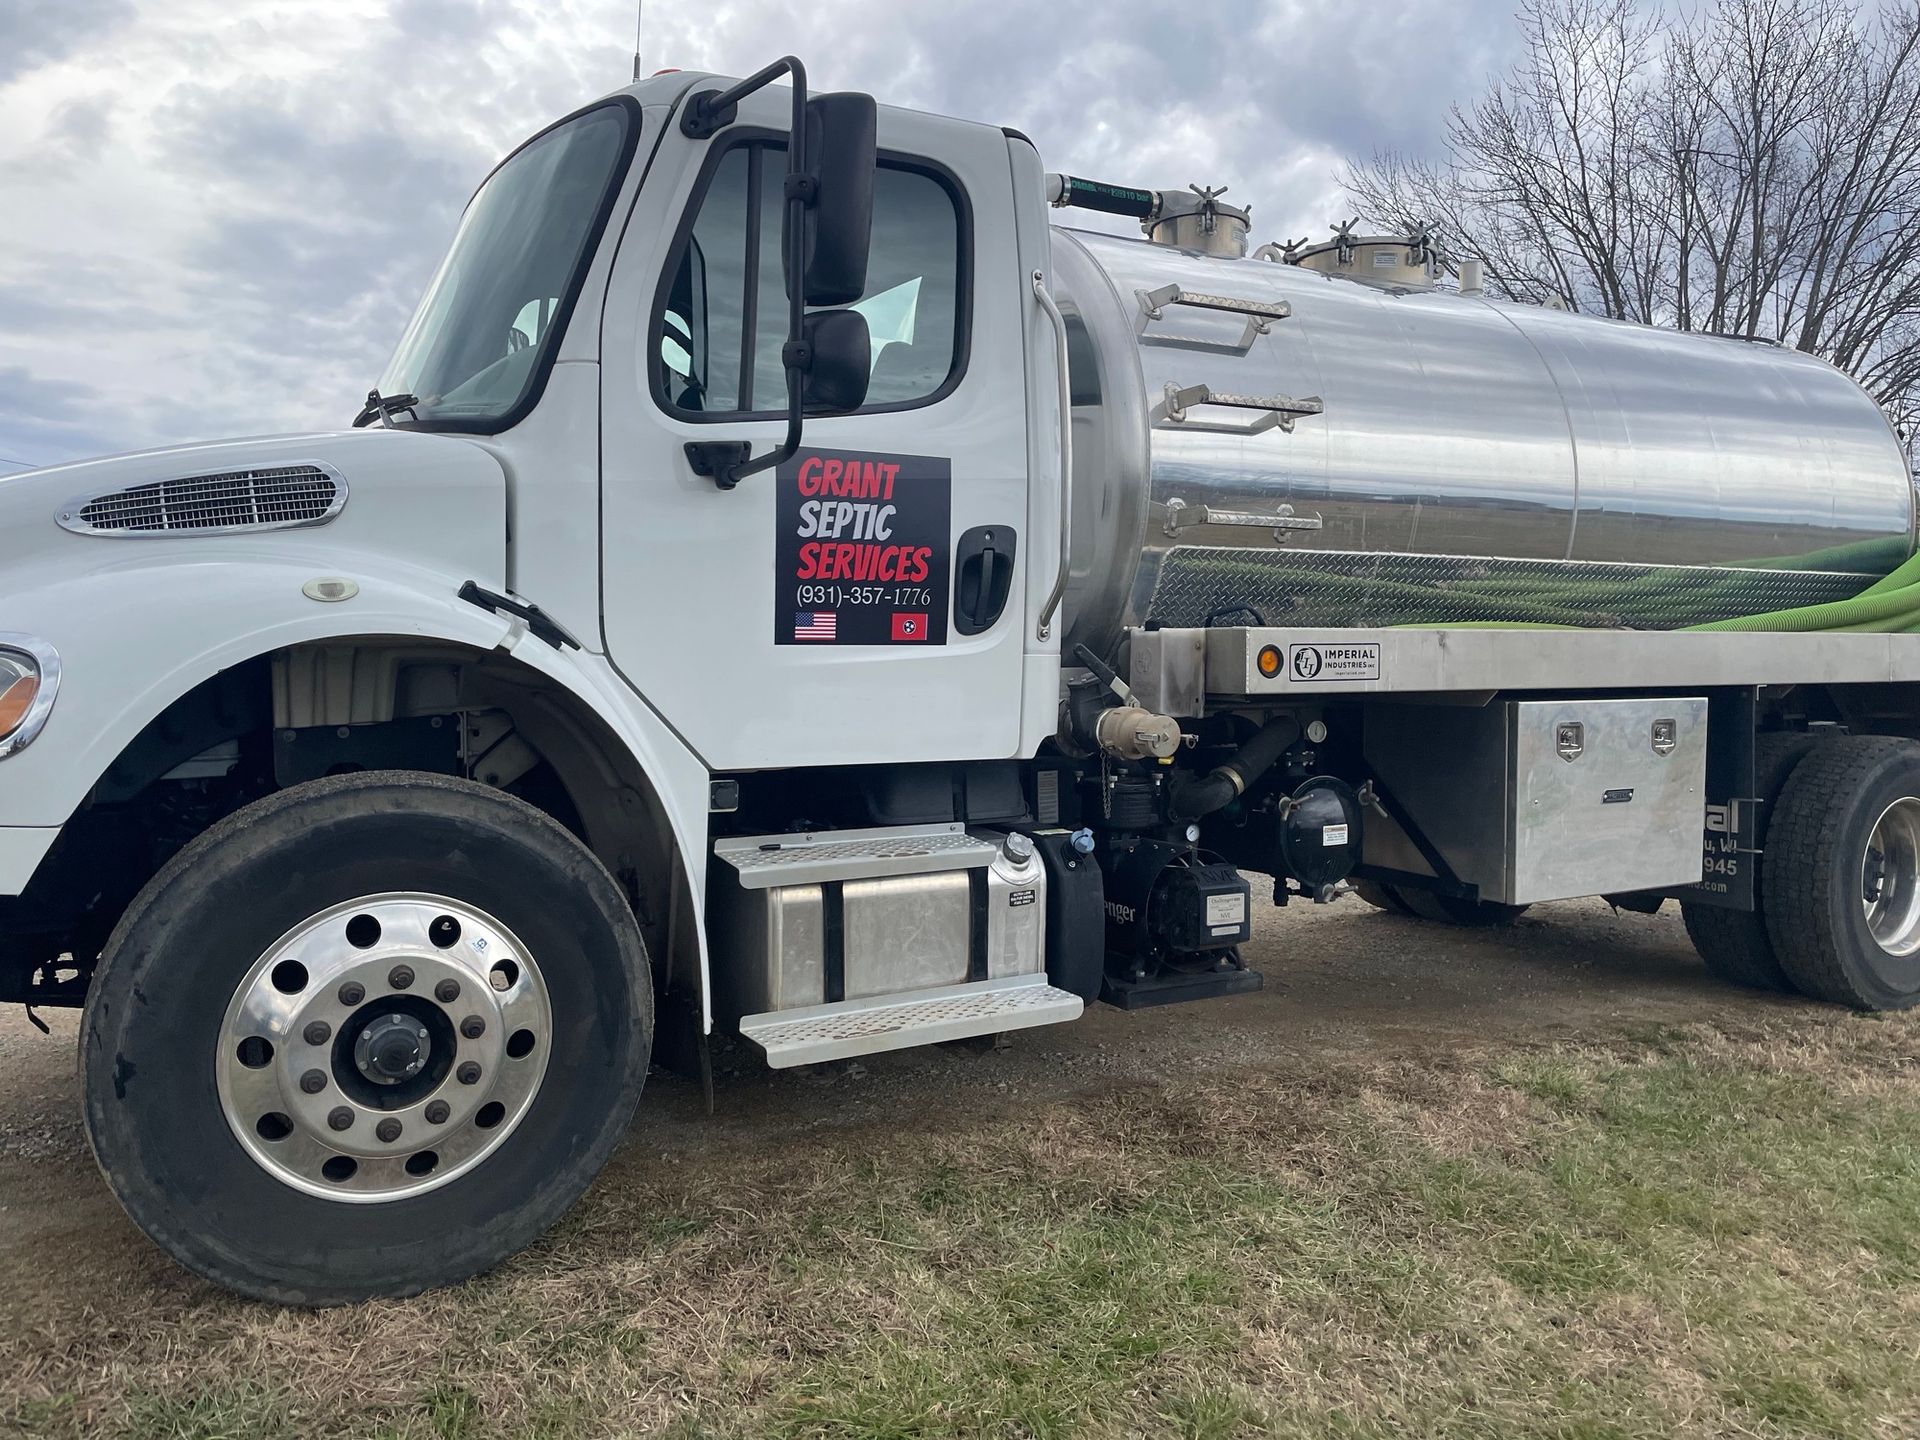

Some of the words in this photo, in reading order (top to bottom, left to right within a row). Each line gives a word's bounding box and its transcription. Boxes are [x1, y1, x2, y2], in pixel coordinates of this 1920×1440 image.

[797, 456, 900, 500] GRANT
[797, 500, 897, 541] SEPTIC
[797, 541, 933, 583] SERVICES
[797, 585, 931, 608] (931)-357-1776
[1325, 650, 1375, 659] IMPERIAL
[1704, 857, 1737, 876] 945
